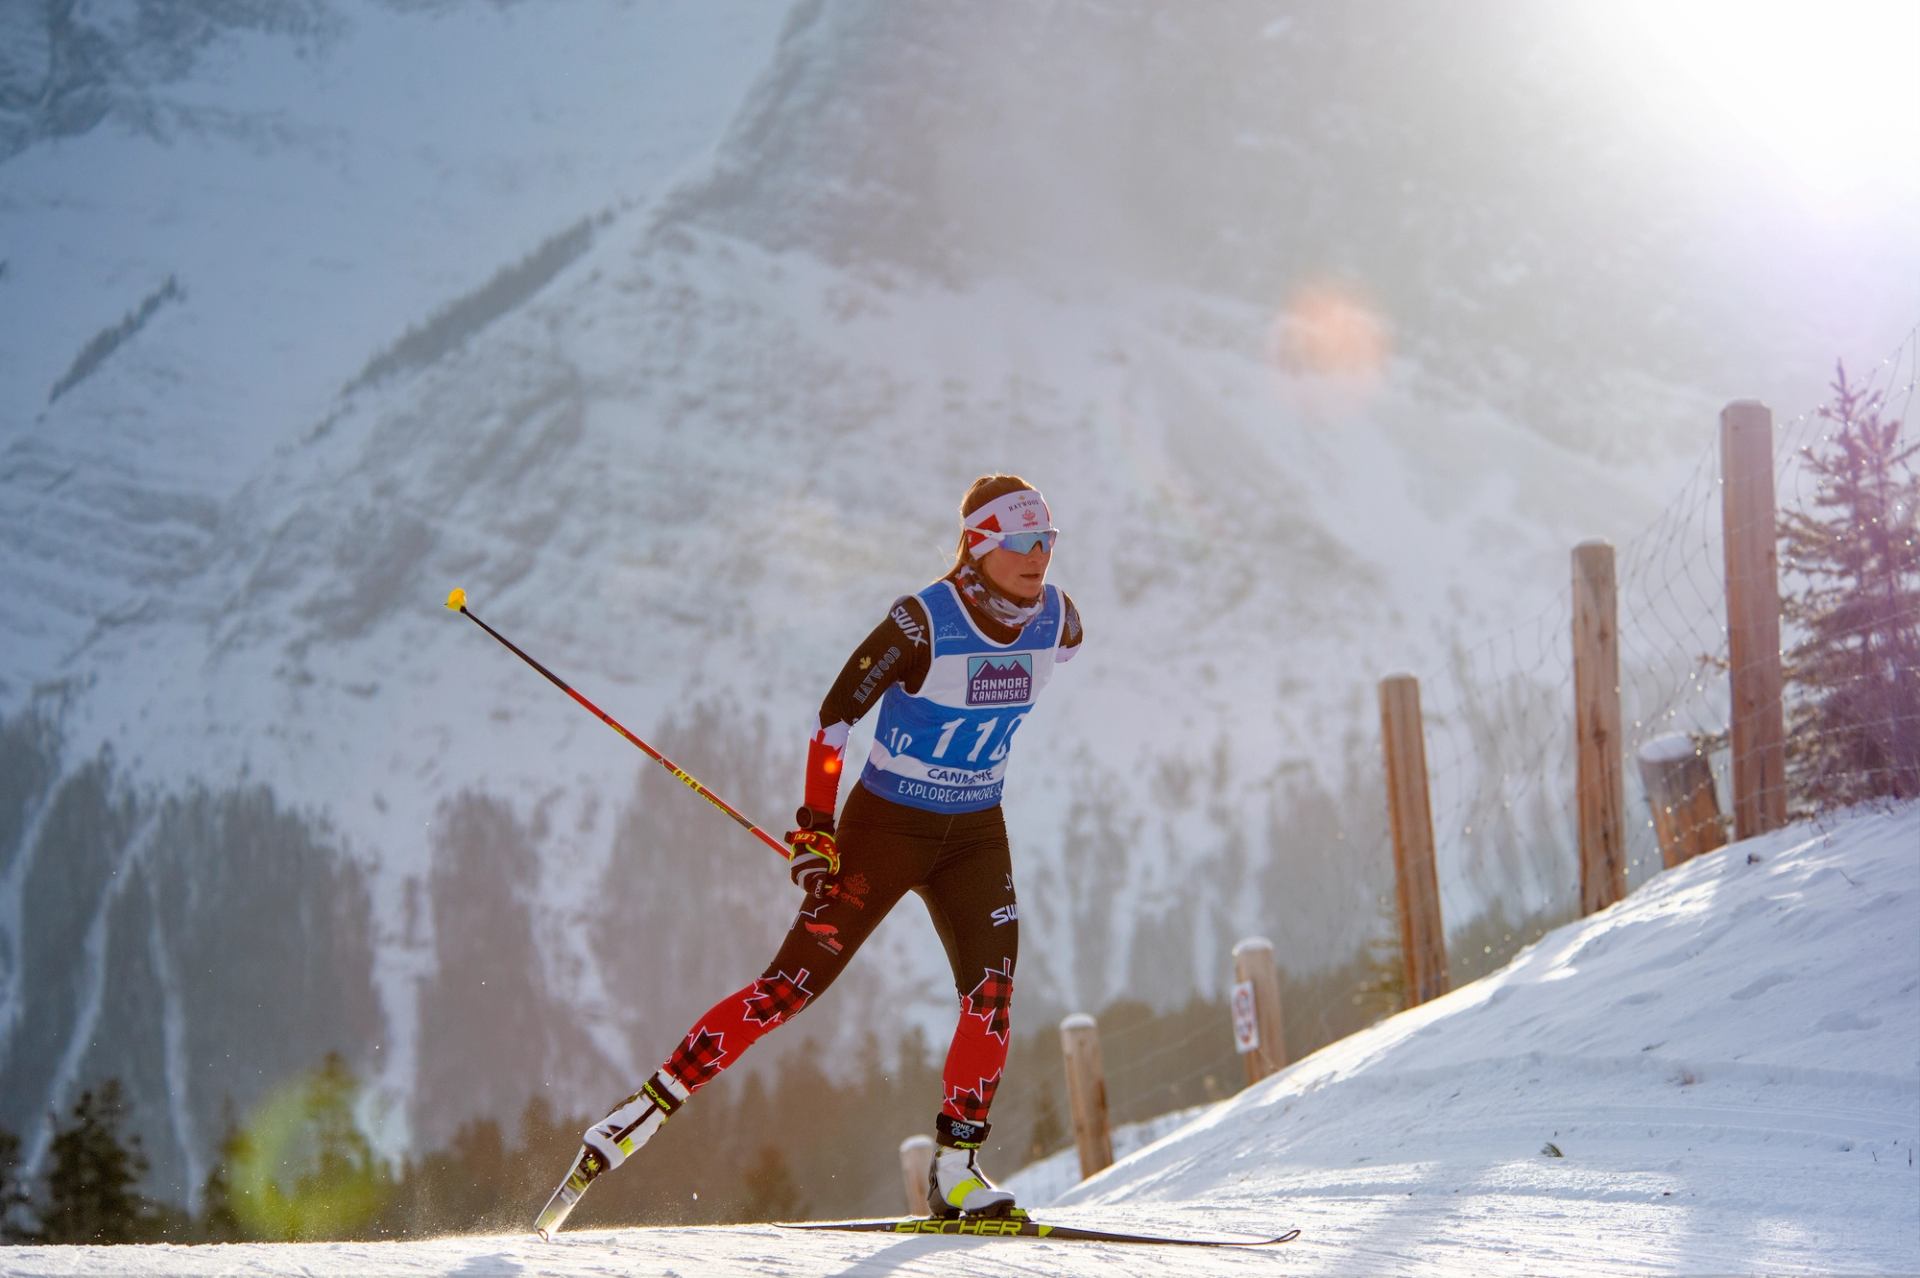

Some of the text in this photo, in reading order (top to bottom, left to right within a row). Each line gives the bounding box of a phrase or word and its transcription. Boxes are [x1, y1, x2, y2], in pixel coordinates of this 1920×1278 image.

[853, 646, 901, 704] HAYWOOD
[972, 677, 1029, 691] CANMORE
[971, 689, 1028, 702] KANANASKIS
[895, 1219, 1022, 1237] FISCHER
